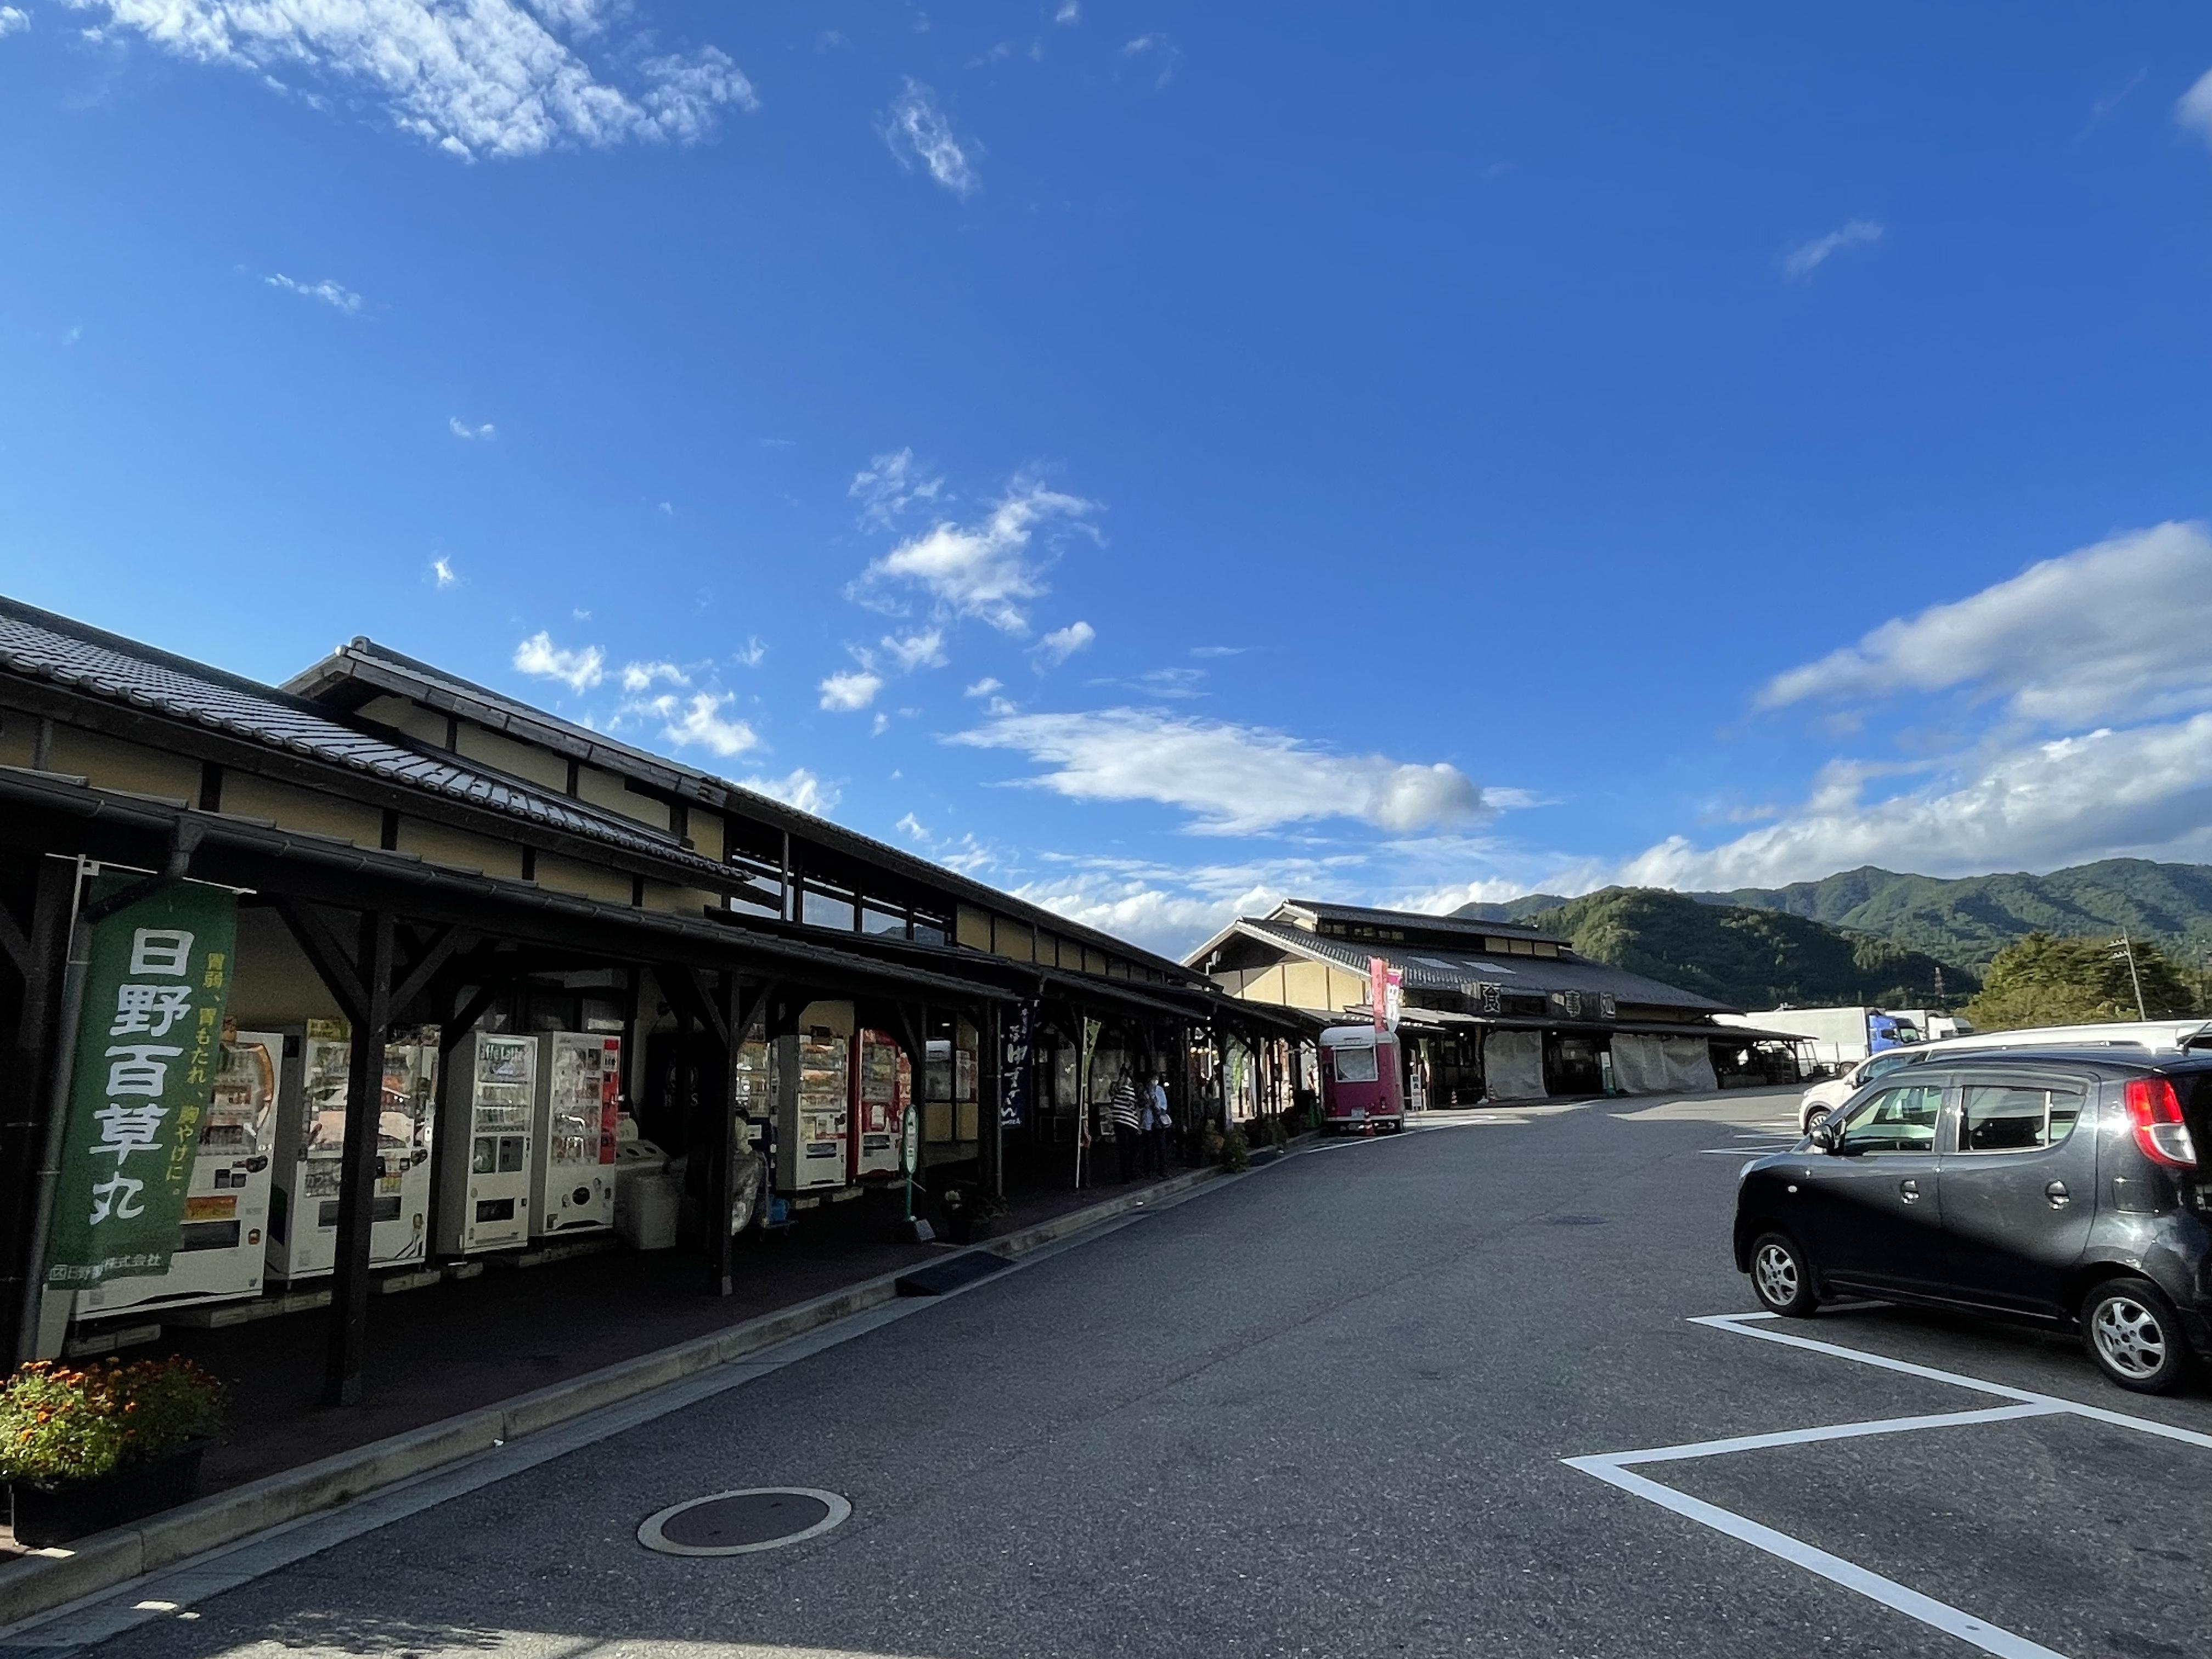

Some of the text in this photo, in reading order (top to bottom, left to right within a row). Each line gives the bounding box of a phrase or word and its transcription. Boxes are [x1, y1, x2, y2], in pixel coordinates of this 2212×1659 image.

[89, 927, 195, 1225] 日野百草丸
